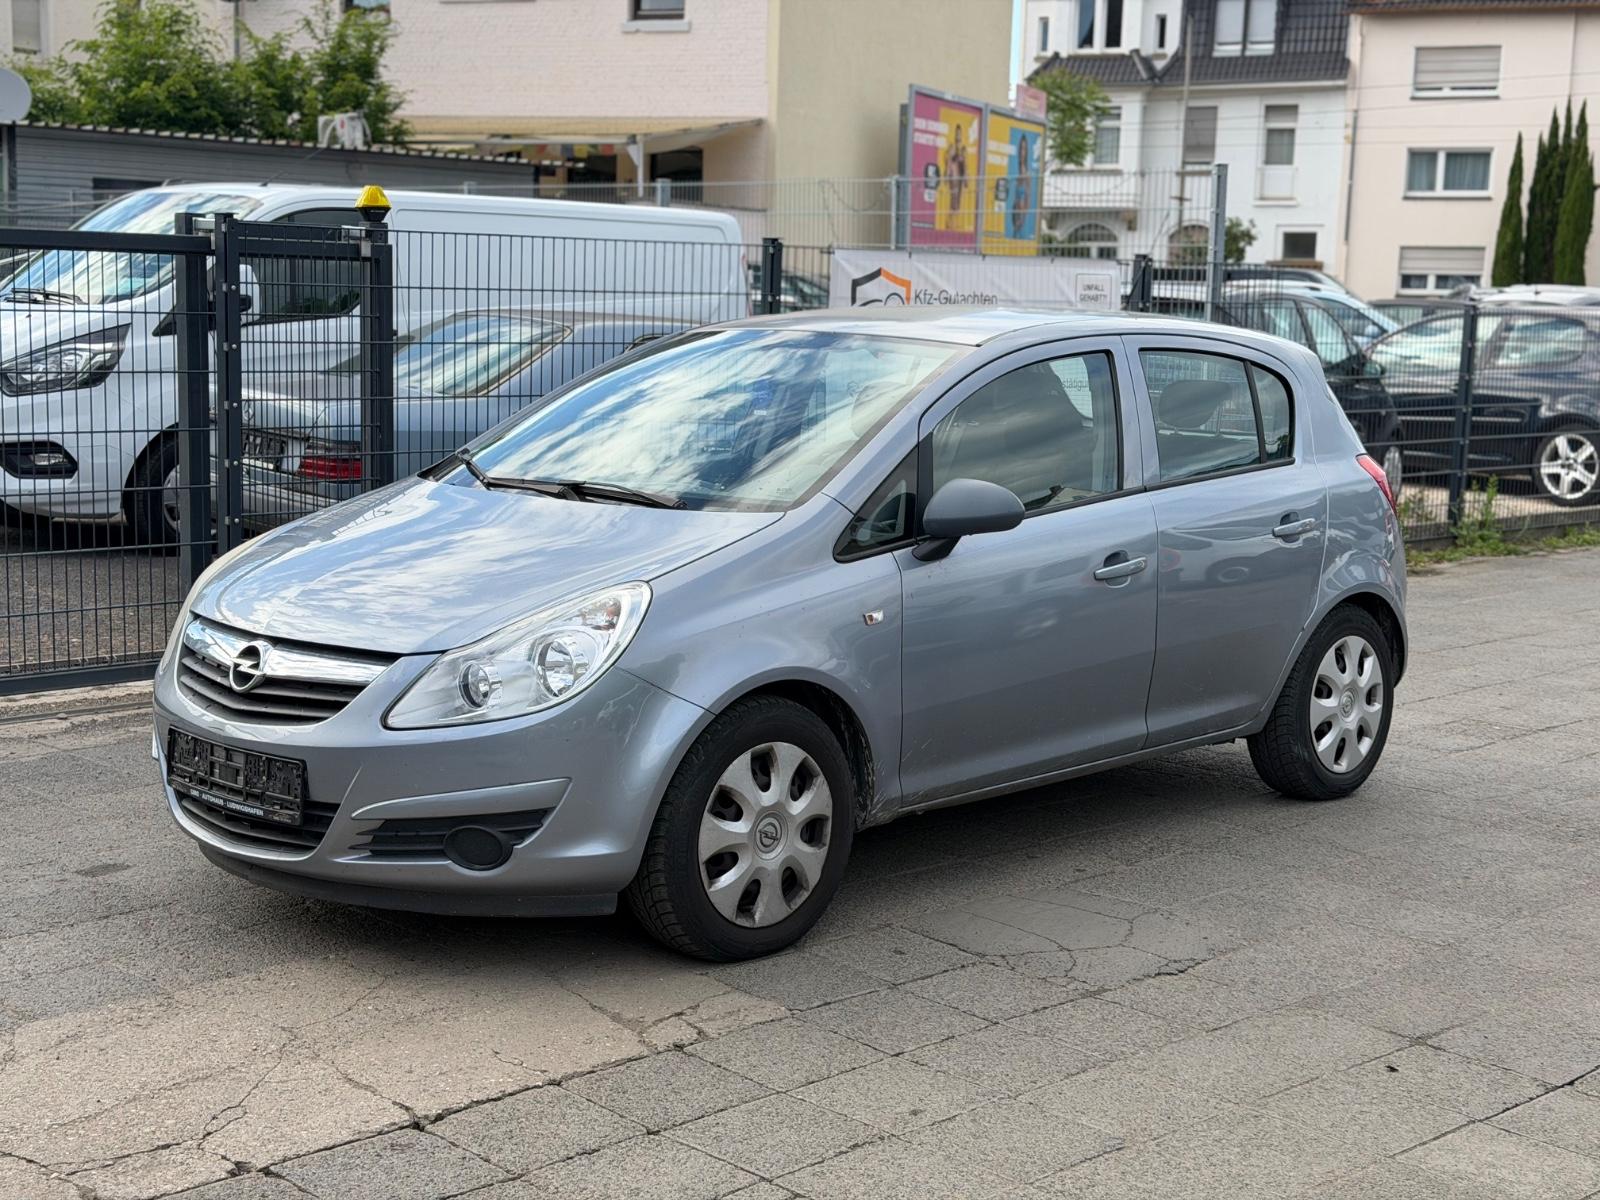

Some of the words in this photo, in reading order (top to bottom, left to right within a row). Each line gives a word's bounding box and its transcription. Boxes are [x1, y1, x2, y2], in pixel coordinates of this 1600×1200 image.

[914, 288, 998, 305] Kfz-Gutachten
[201, 793, 224, 806] AUTOHAUS
[226, 801, 264, 816] LUDWIGSHAFEN
